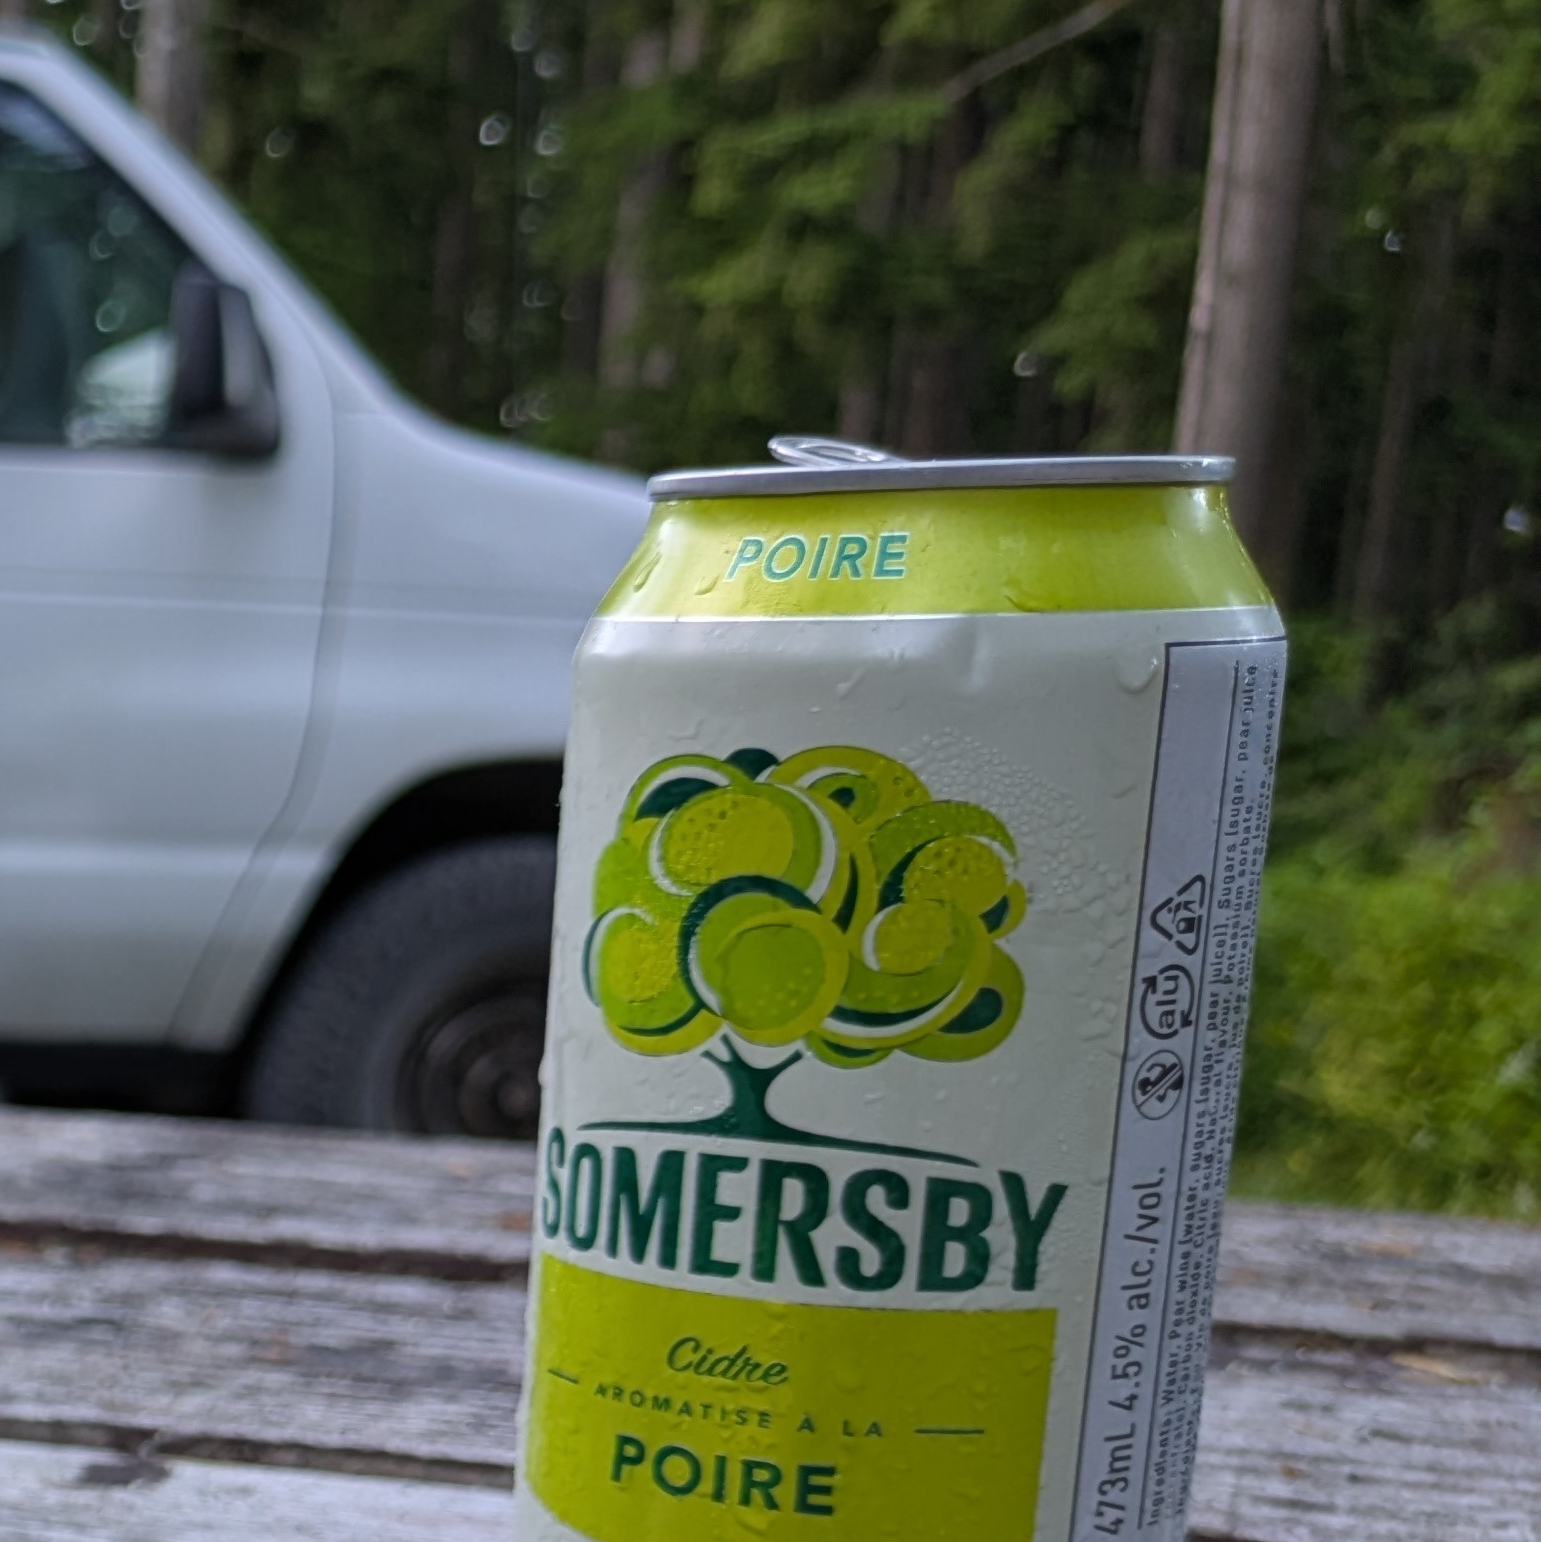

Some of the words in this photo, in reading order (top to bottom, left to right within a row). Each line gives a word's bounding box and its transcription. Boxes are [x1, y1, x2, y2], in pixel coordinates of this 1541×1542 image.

[724, 531, 910, 582] POIRE
[1155, 974, 1180, 1030] alu
[541, 1126, 1068, 1293] SOMERSBY
[1120, 1166, 1166, 1312] alc./vol.
[667, 1336, 789, 1385] Cidre
[1107, 1323, 1147, 1412] 4.5%
[842, 1420, 883, 1437] LA
[610, 1434, 837, 1516] POIRE
[1093, 1423, 1136, 1535] 473mL
